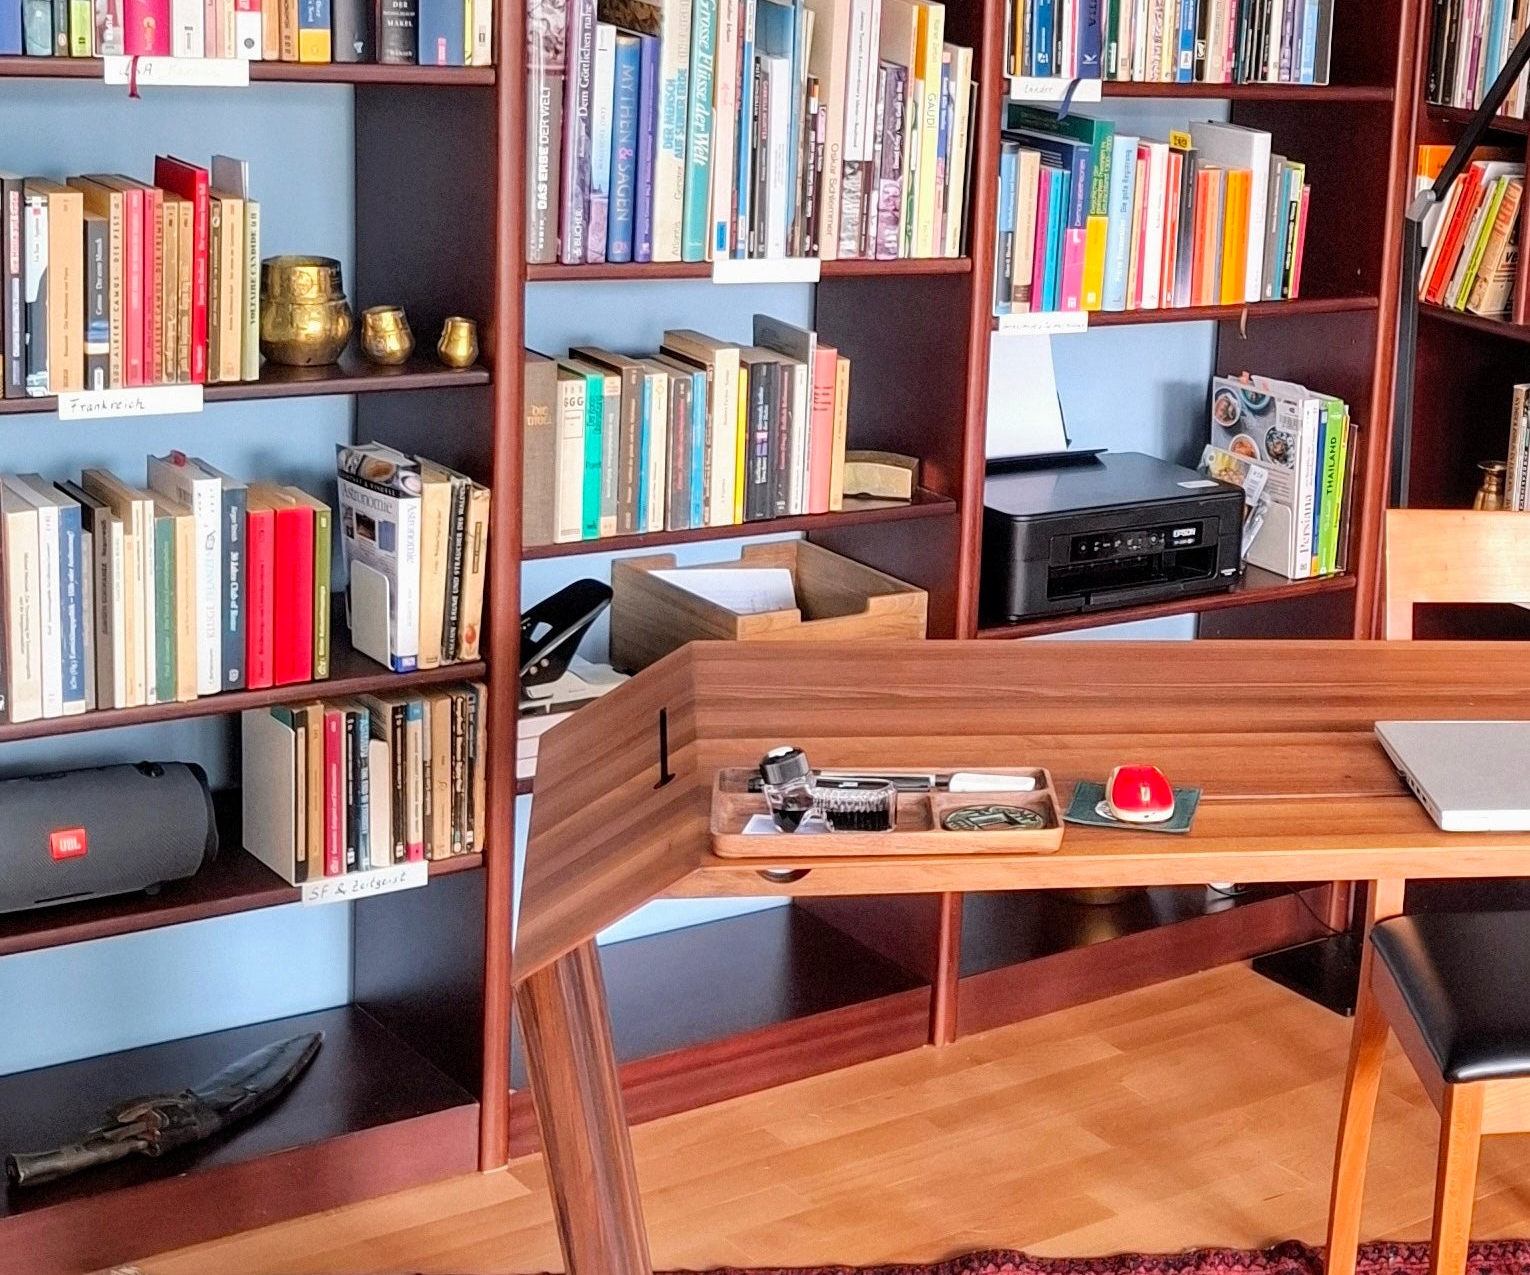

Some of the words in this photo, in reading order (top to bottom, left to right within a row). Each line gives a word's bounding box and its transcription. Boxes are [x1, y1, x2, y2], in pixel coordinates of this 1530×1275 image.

[578, 95, 588, 117] Dem
[620, 64, 636, 144] MYTHEN
[540, 149, 549, 184] ERBE
[618, 147, 633, 160] &
[830, 142, 839, 172] Oskar
[537, 187, 548, 210] DAS
[616, 164, 633, 221] SAGEN
[823, 174, 839, 237] Schlemmer
[70, 398, 145, 413] Frankreich
[1327, 436, 1336, 495] THAILAND
[1300, 494, 1312, 554] Persiana
[308, 886, 329, 900] SF
[351, 870, 407, 893] Zeitgeist
